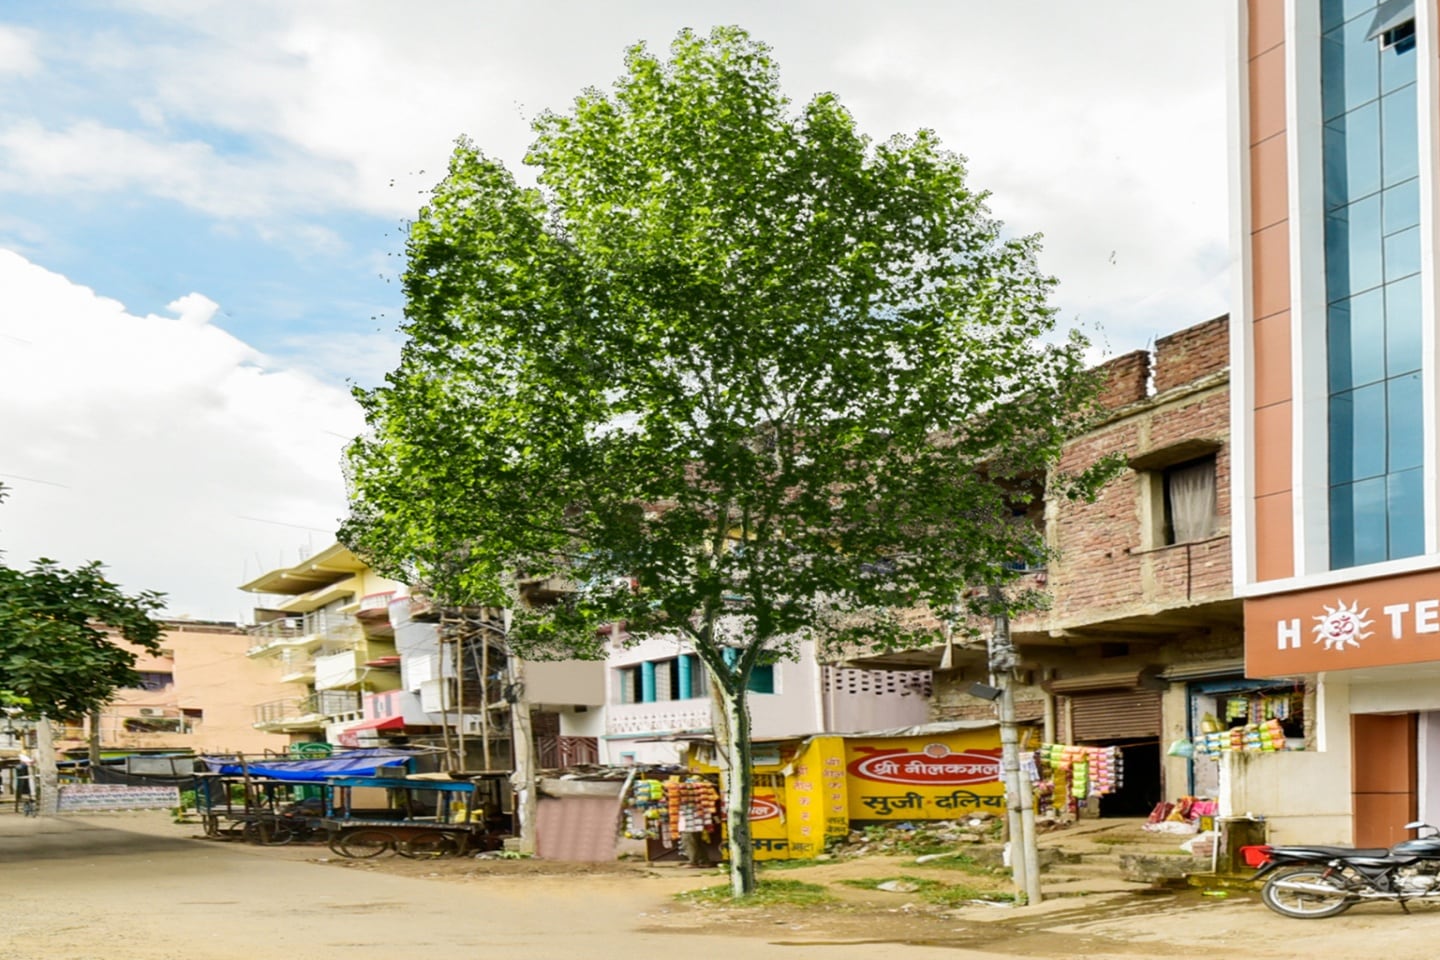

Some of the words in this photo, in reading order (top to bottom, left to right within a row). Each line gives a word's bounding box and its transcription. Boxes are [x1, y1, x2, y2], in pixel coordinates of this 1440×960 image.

[873, 760, 901, 776] श्री
[904, 760, 999, 776] नीलकमल
[861, 792, 926, 815] सुजी
